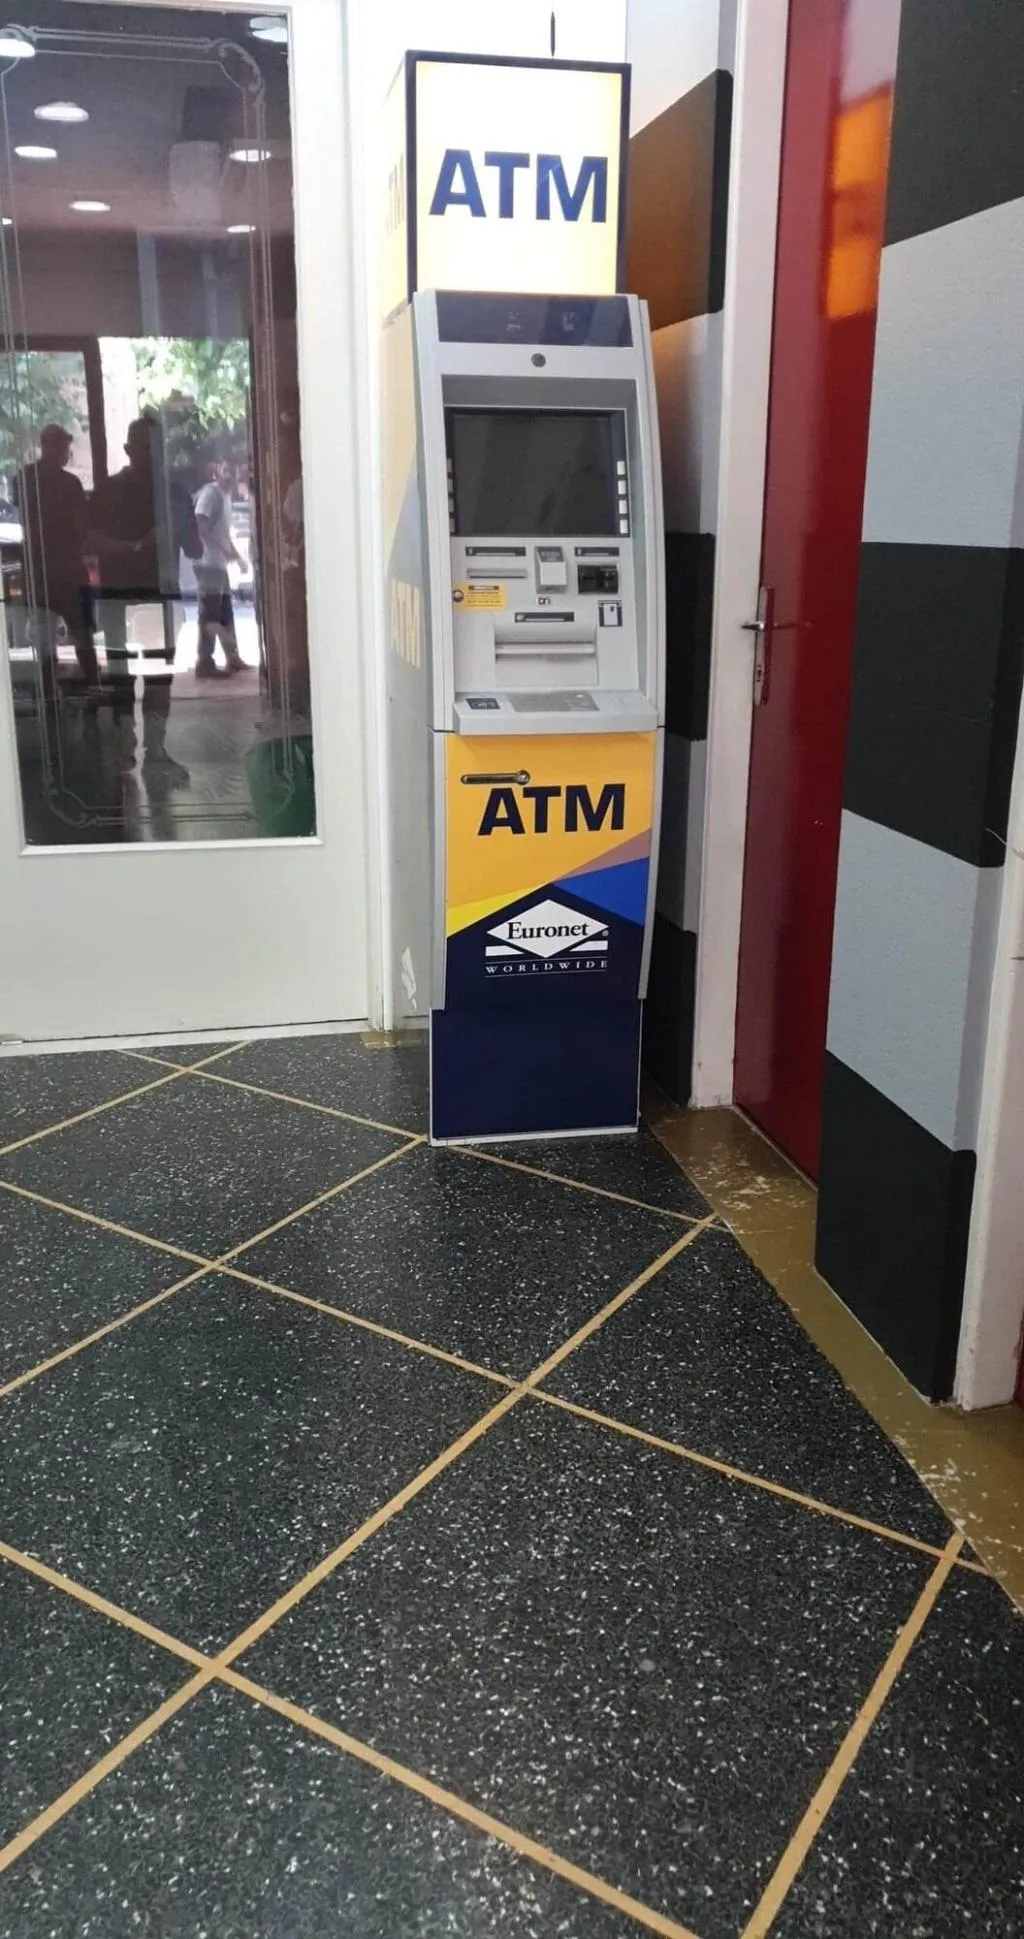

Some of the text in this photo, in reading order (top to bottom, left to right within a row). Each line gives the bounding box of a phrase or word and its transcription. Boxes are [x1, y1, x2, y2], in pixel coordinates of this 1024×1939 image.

[428, 148, 608, 223] ATM
[477, 783, 626, 836] ATM
[507, 921, 590, 940] Euronet
[485, 959, 609, 975] WORLDWIDE
